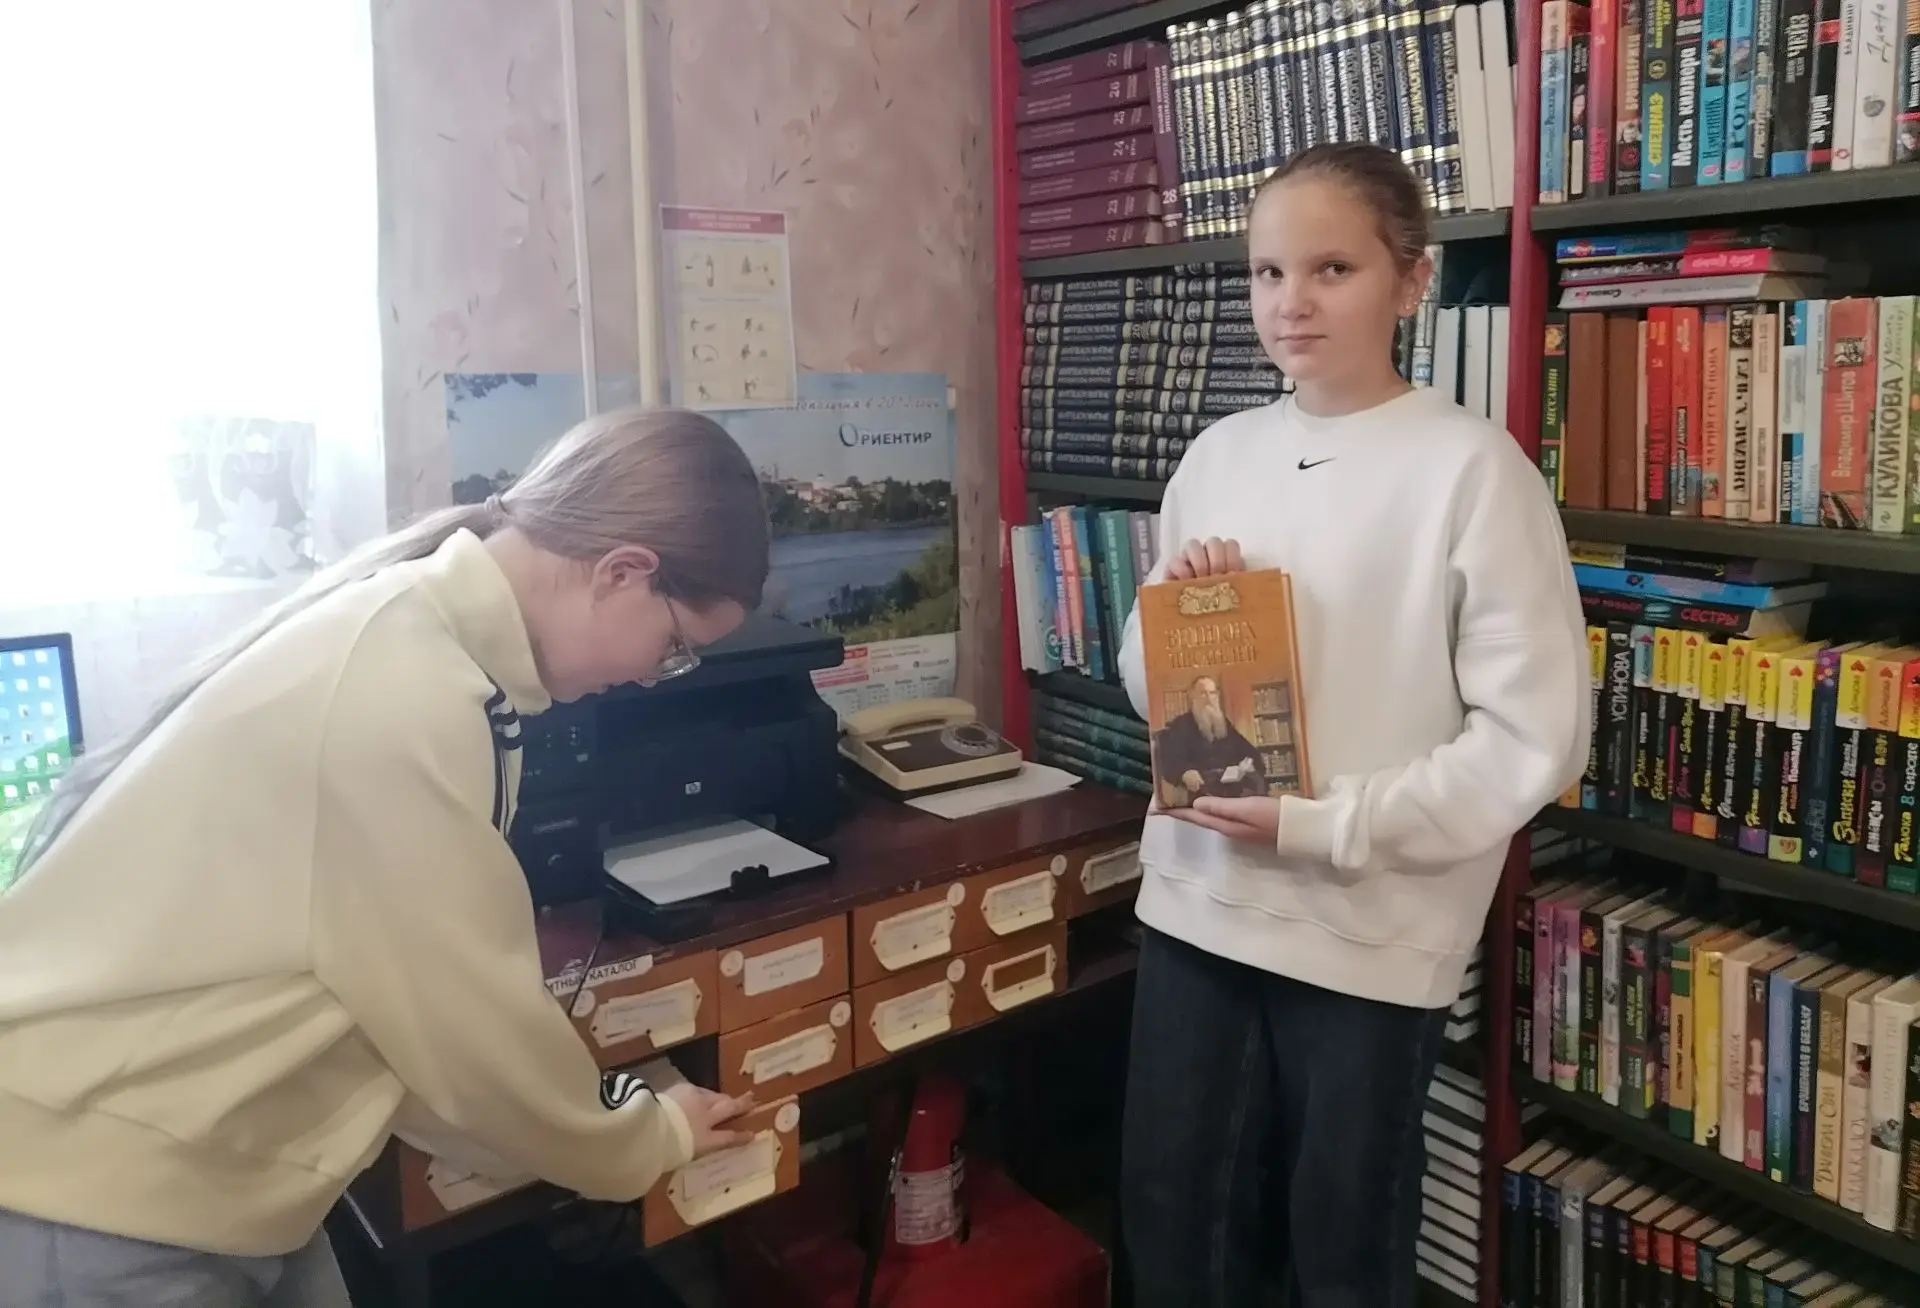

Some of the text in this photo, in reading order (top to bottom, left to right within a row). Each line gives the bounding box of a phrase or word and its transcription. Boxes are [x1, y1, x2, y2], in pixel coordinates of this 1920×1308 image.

[1784, 14, 1810, 57] ЧЕЙЗ
[1261, 67, 1274, 156] ЭНЦИКЛОПЕДИЯ
[1371, 41, 1389, 138] ЭНЦИКЛОПЕДИЯ
[1405, 36, 1424, 134] ЭНЦИКЛОПЕДИЯ
[1442, 32, 1456, 131] ЭНЦИКЛОПЕДИЯ
[1678, 47, 1701, 116] киллера
[1649, 92, 1664, 167] СПЕЦНАЗ
[1671, 118, 1693, 167] Месть
[1162, 188, 1178, 205] 28
[1831, 370, 1859, 478] Владимир Шитов
[1876, 376, 1903, 500] КУЛИКОВА
[1680, 608, 1739, 627] СЕСТРЫ
[1610, 650, 1630, 722] УСТИНОВА
[1832, 779, 1861, 844] Записки
[1893, 811, 1914, 862] Гадюка
[1904, 743, 1918, 792] сиропе
[589, 960, 637, 981] КАТАЛОГ
